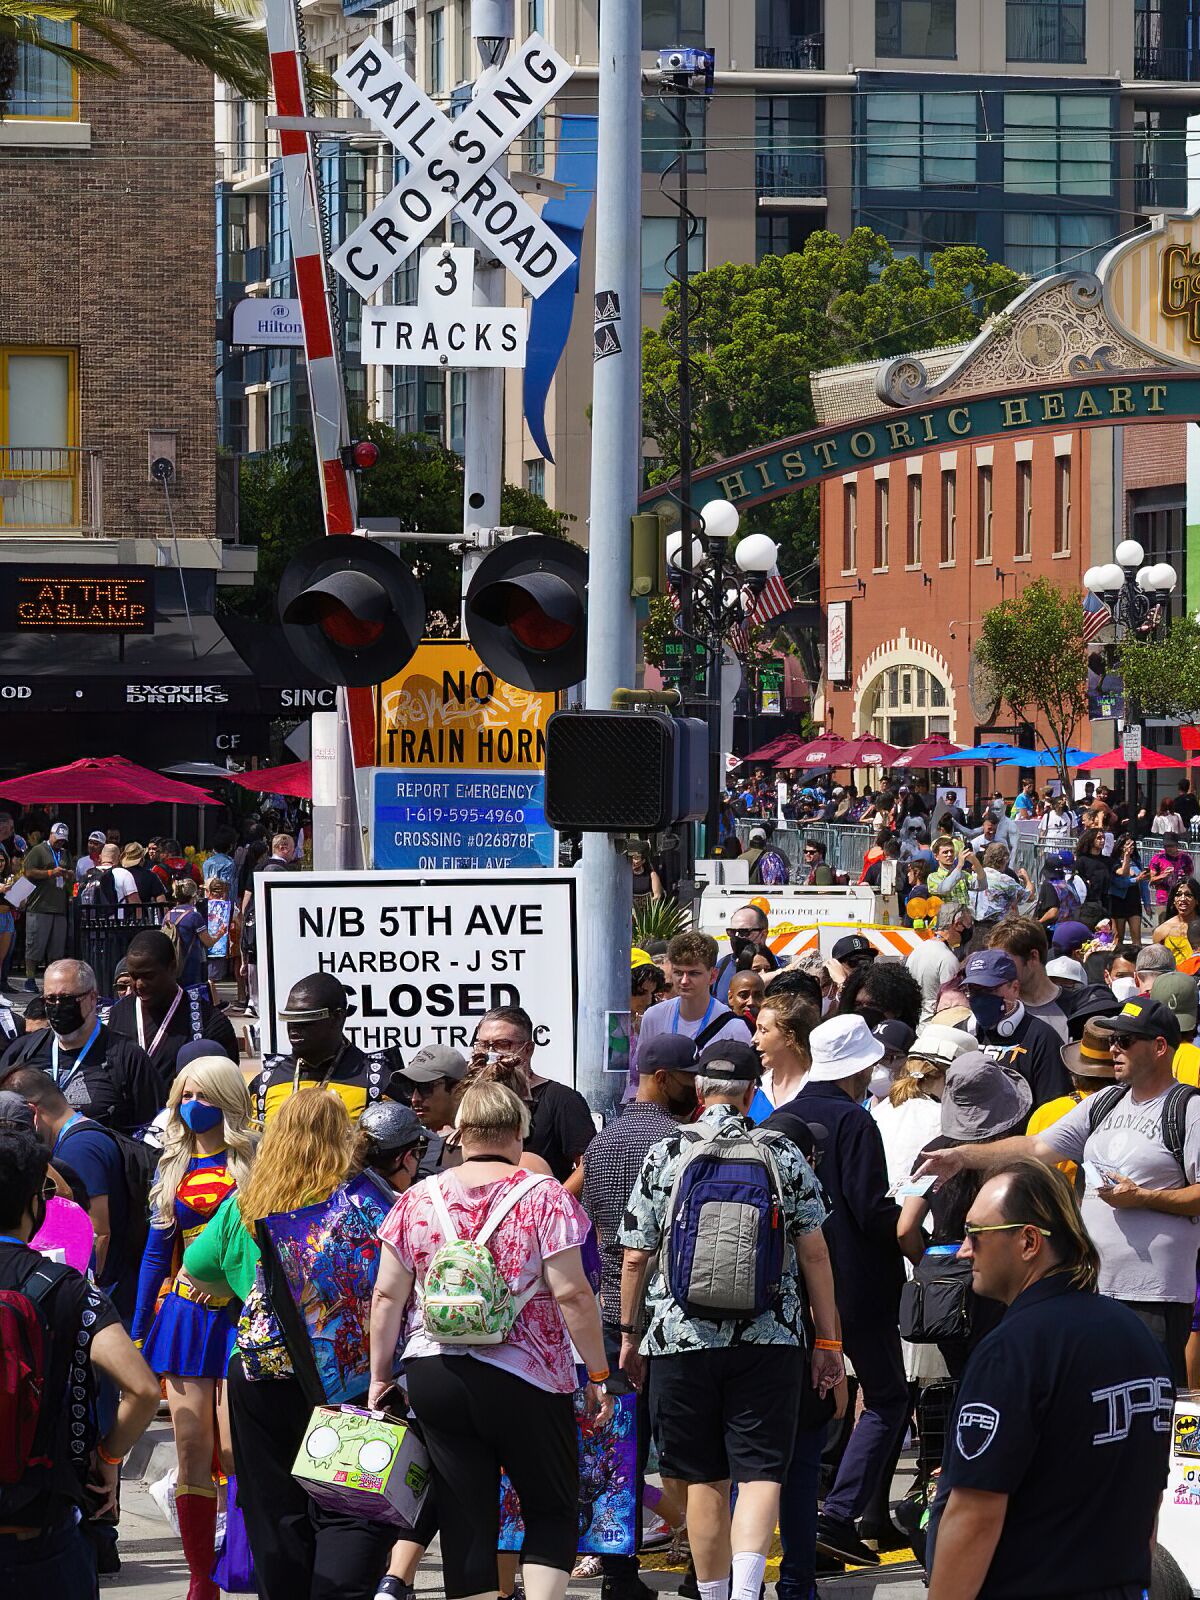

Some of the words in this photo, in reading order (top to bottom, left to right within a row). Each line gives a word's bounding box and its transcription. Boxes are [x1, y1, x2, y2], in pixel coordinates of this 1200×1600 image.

[346, 49, 557, 281] CROSSING
[434, 258, 457, 296] 3
[258, 320, 303, 333] Hilton
[371, 322, 518, 351] TRACKS
[716, 405, 972, 501] HISTORIC
[1001, 384, 1168, 427] HEART
[38, 585, 69, 601] AT
[79, 585, 128, 601] THE
[18, 603, 145, 620] GASLAMP
[126, 685, 223, 694] EXOTIC
[442, 670, 494, 705] NO
[126, 694, 229, 704] DRINKS
[280, 688, 338, 707] SINC
[387, 728, 464, 764] TRAIN
[478, 728, 546, 764] HORN
[397, 783, 450, 798] REPORT
[456, 784, 534, 799] EMERGENCY
[406, 807, 525, 823] 1-619-595-4960
[395, 831, 461, 847] CROSSING
[467, 833, 535, 848] #026878F
[419, 856, 436, 870] ON
[486, 857, 512, 870] AVE
[299, 906, 365, 938] N/B
[379, 905, 452, 937] 5TH
[464, 904, 543, 936] AVE
[318, 951, 441, 973] HARBOR
[467, 950, 480, 971] J
[491, 950, 526, 971] ST
[349, 1026, 421, 1048] THRU
